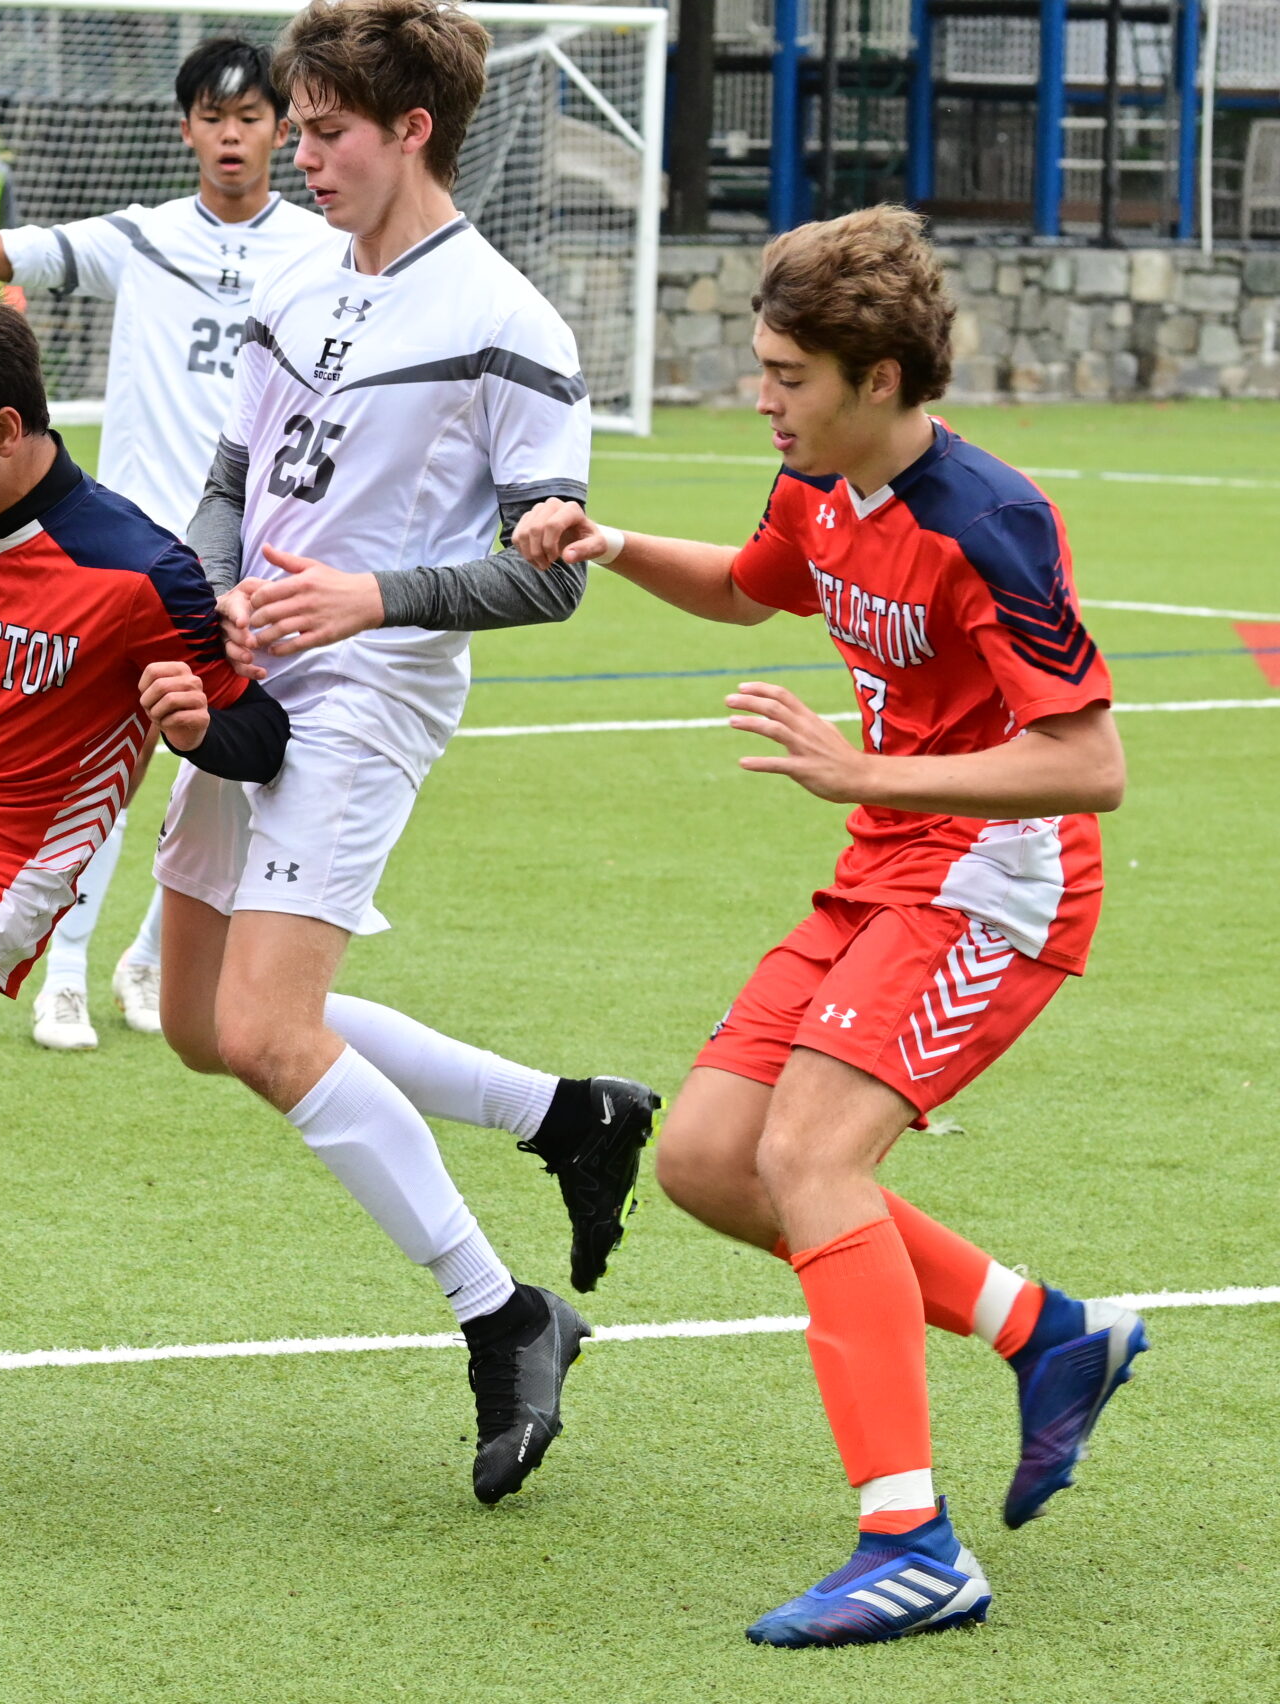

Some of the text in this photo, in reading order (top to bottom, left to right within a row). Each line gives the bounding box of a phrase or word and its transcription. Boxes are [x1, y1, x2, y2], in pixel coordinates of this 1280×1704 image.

[219, 268, 241, 288] H
[315, 337, 353, 371] H
[267, 414, 347, 505] 25
[853, 667, 888, 753] 7
